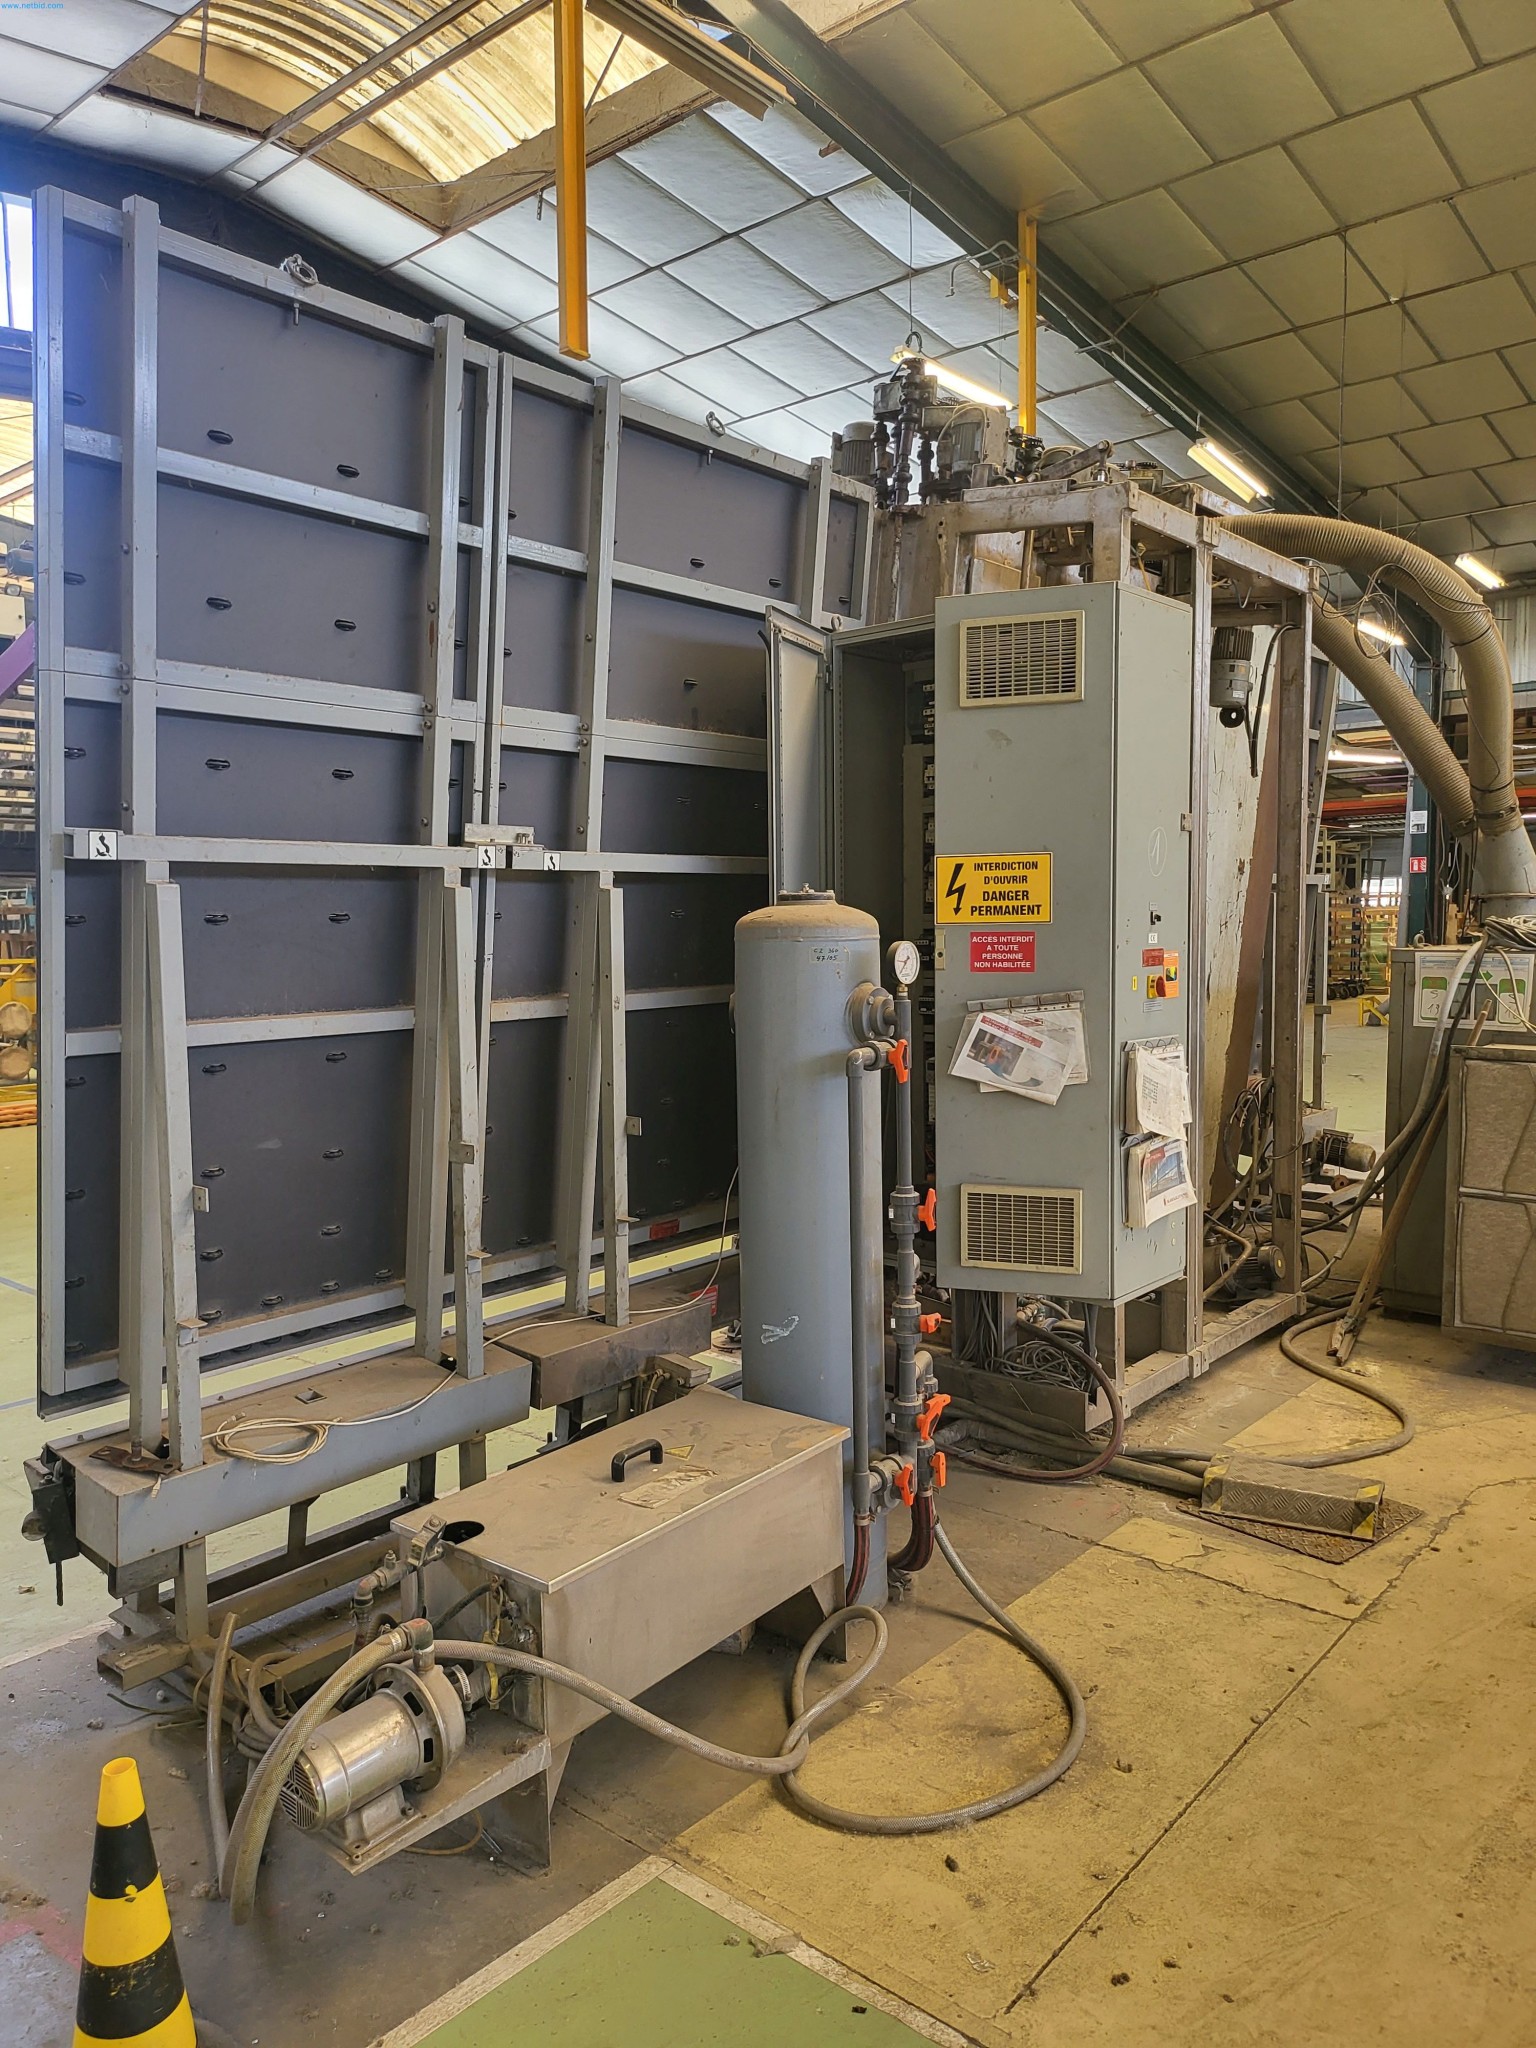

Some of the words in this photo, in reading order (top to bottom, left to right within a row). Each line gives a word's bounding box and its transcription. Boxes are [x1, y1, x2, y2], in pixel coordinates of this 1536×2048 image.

[973, 861, 1038, 871] INTERDICTION
[983, 875, 1028, 885] D'OUVRIR
[982, 890, 1029, 902] DANGER
[970, 904, 1042, 916] PERMANENT
[999, 935, 1034, 943] INTERDIT
[992, 960, 1032, 968] HABILITÉE
